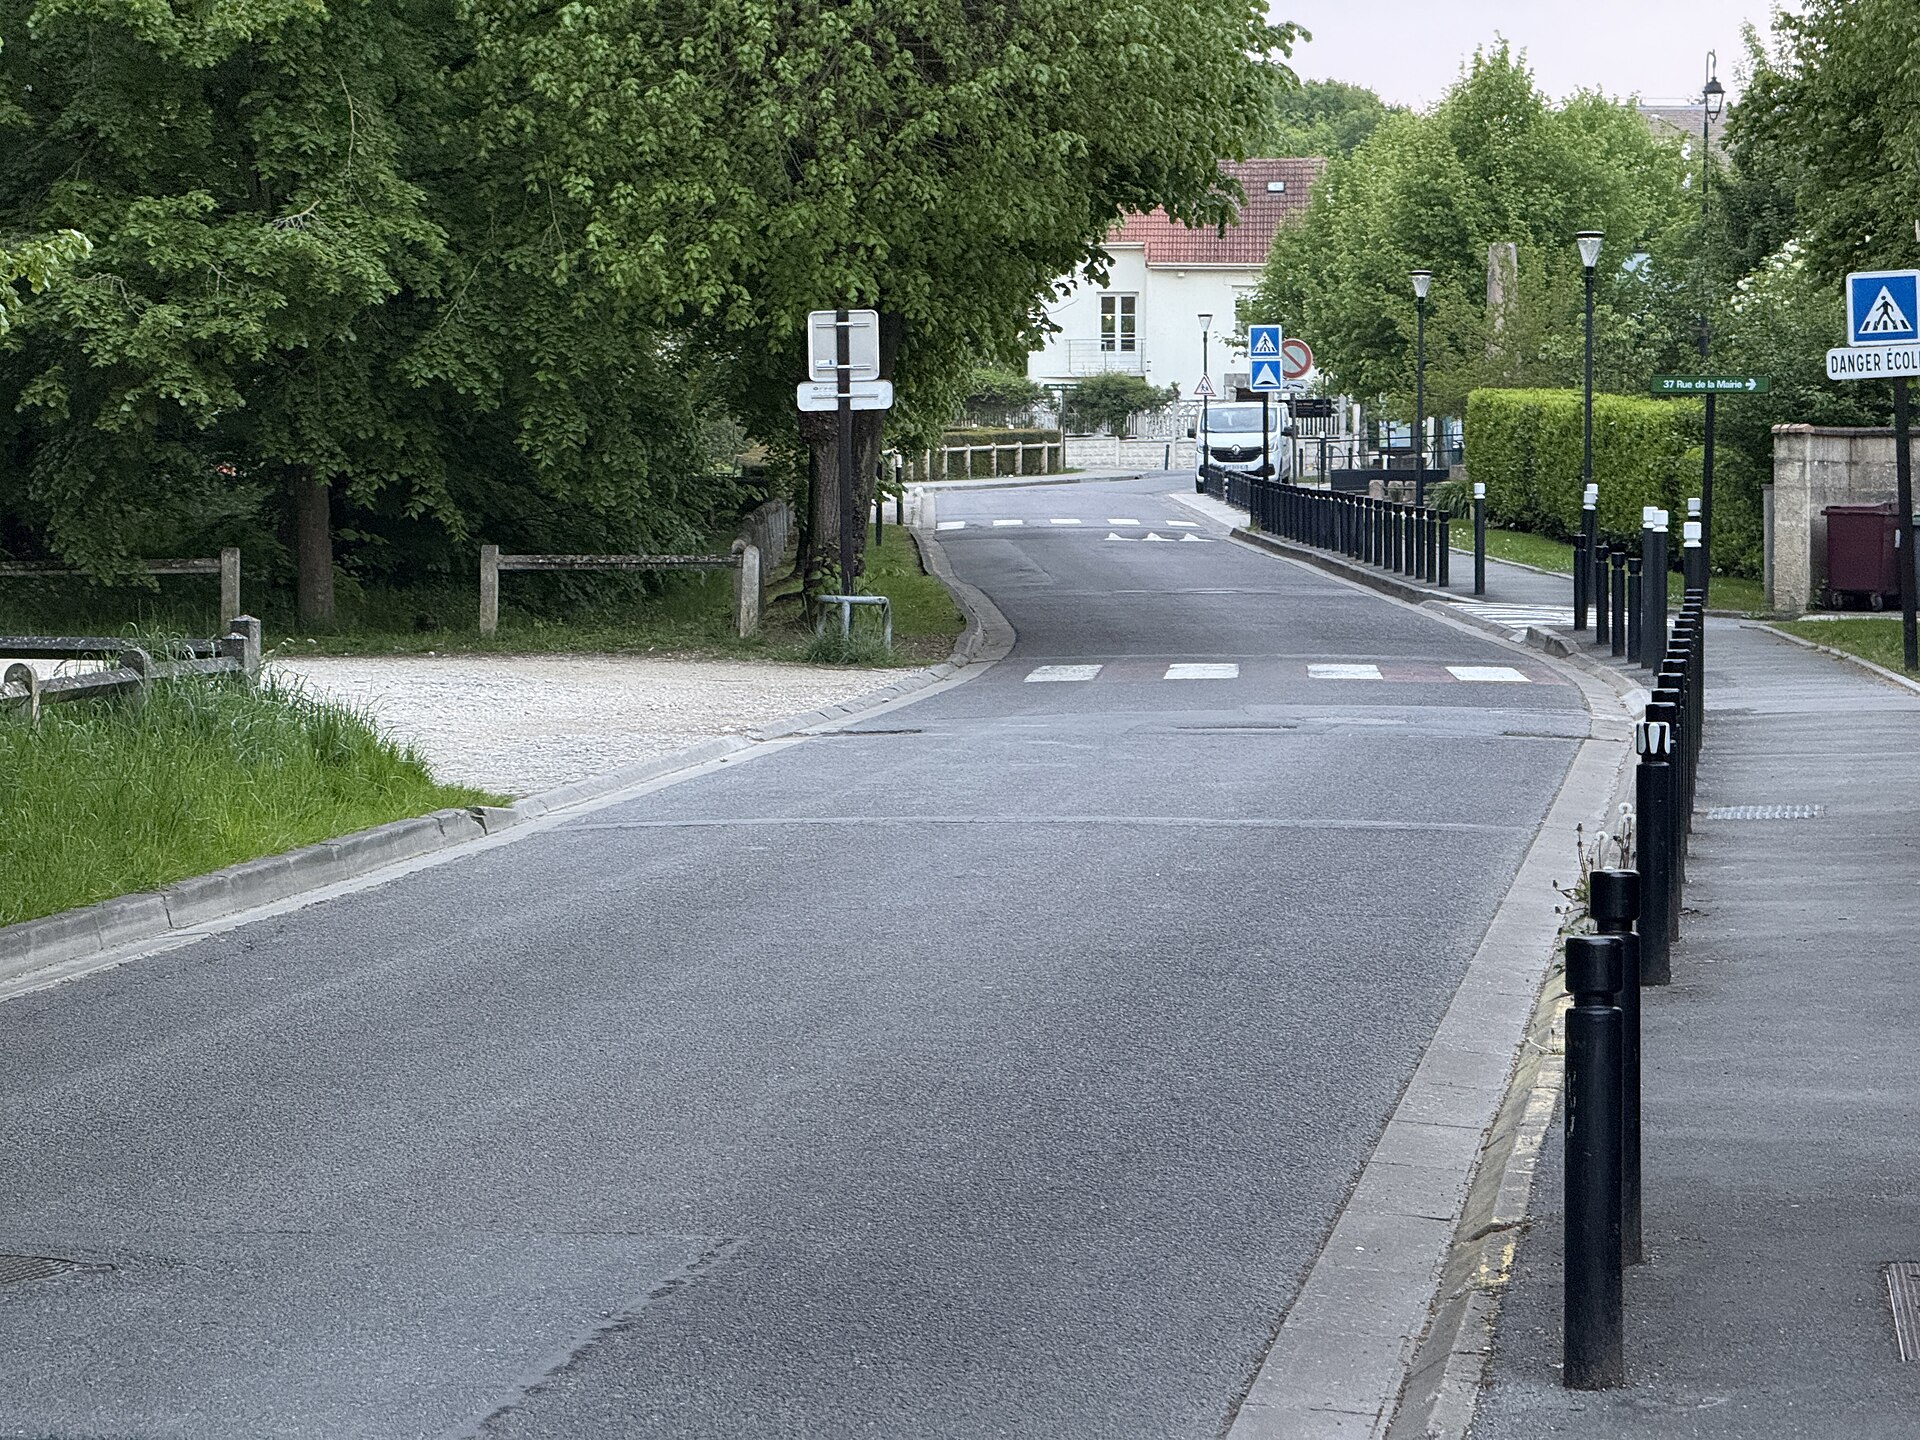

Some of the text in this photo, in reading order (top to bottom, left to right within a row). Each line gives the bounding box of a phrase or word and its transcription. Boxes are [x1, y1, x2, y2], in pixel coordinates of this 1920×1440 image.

[1831, 348, 1920, 374] DANGER ÉCOL
[1663, 379, 1743, 389] 37 Rue de la Mairie
